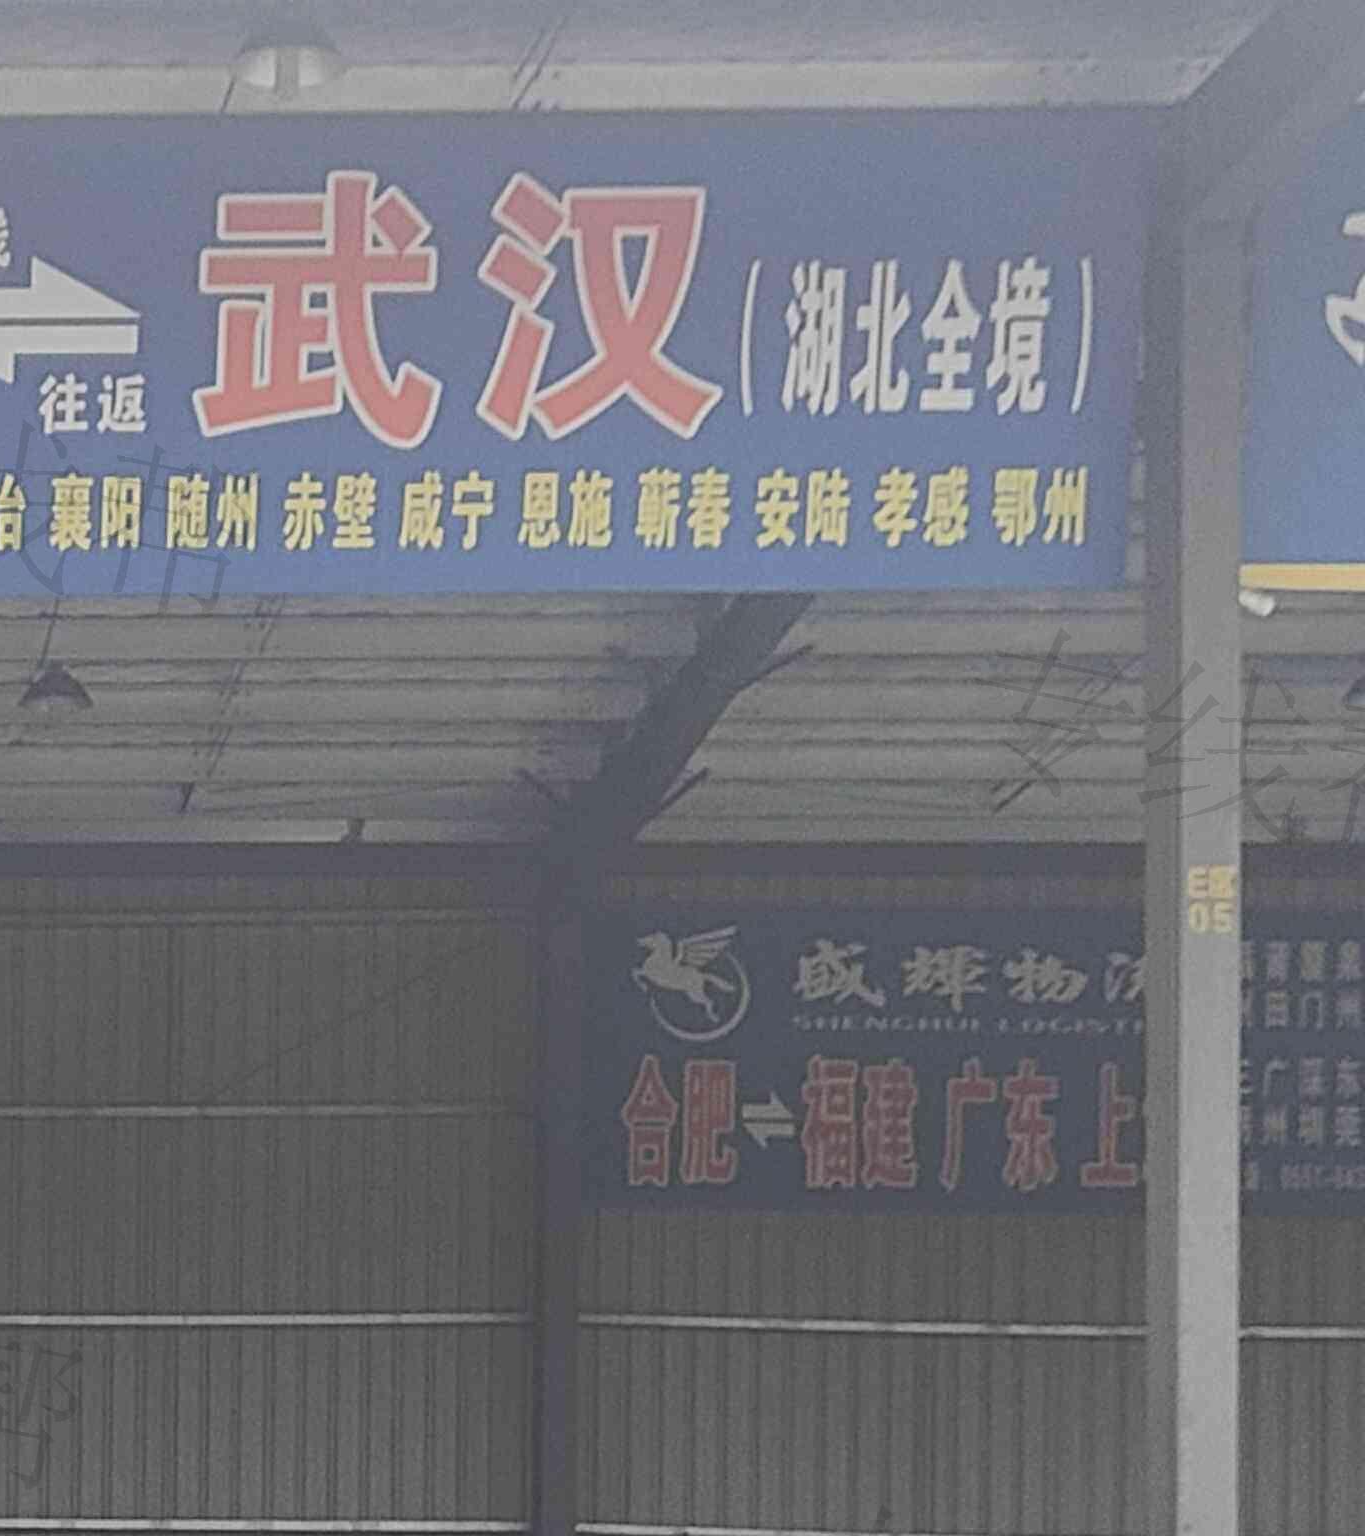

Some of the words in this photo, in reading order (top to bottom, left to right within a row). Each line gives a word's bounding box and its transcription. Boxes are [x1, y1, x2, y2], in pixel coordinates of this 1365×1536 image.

[193, 168, 724, 450] 武汉
[37, 374, 148, 434] 往返
[49, 474, 142, 552] 襄阳
[165, 474, 259, 552] 随州
[282, 472, 375, 550] 赤壁
[398, 470, 495, 550] 咸宁
[518, 470, 614, 546] 恩施
[635, 468, 731, 550] 蕲春
[755, 468, 849, 547] 安陆
[873, 467, 968, 547] 孝感
[992, 467, 1091, 545] 鄂州
[1189, 901, 1234, 934] 05
[622, 1053, 739, 1188] 合肥
[800, 1054, 919, 1188] 福建
[940, 1056, 1059, 1190] 广东
